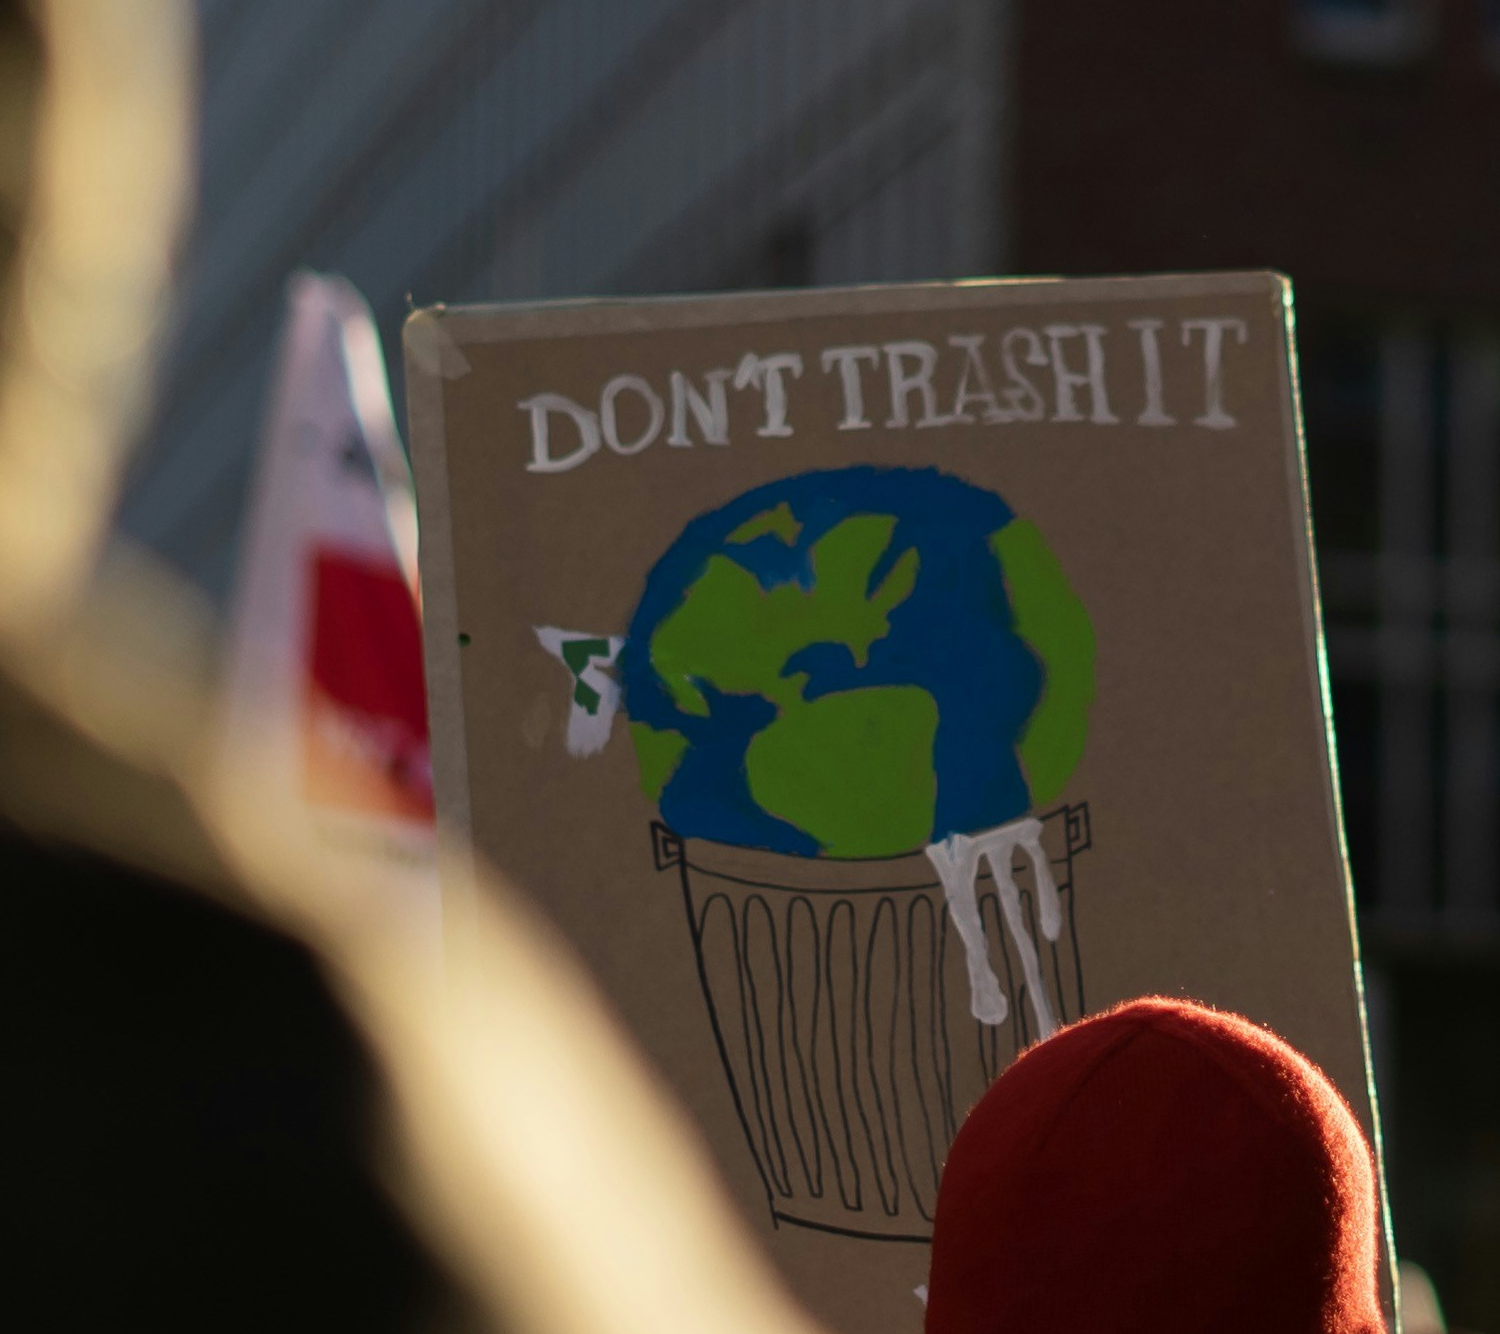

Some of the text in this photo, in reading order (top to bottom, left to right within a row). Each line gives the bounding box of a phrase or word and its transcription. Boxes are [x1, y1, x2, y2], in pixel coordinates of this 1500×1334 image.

[518, 318, 1248, 473] DON'T TRASH IT
